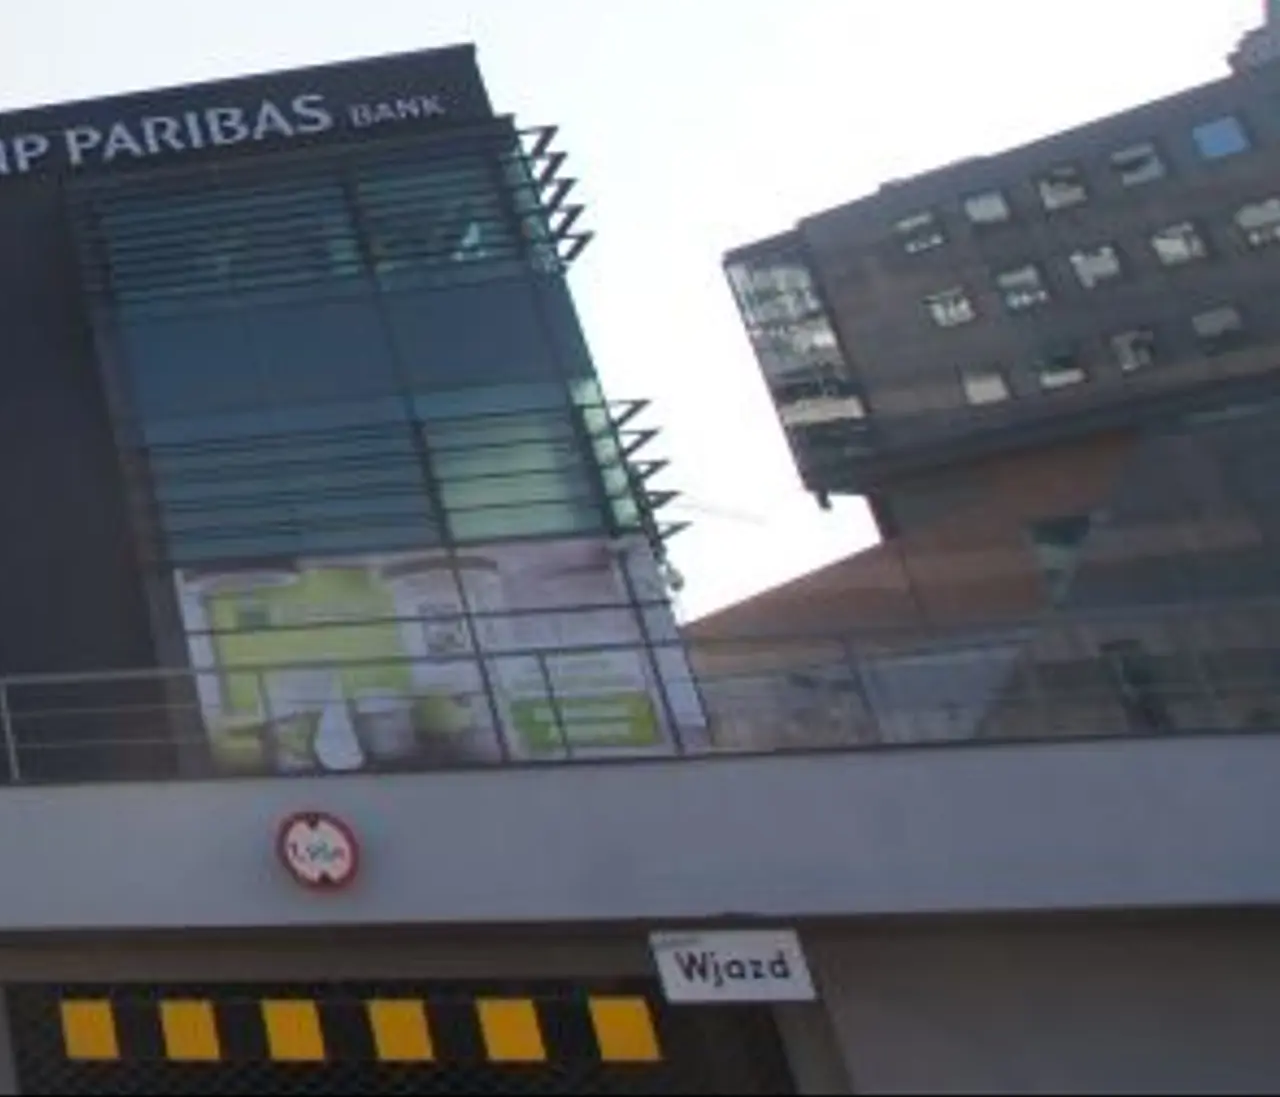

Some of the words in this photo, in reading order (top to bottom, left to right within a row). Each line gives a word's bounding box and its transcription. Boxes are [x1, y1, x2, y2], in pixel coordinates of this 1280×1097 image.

[64, 93, 334, 166] PARIBAS
[350, 95, 446, 129] BANK
[673, 949, 793, 989] Wjazd
